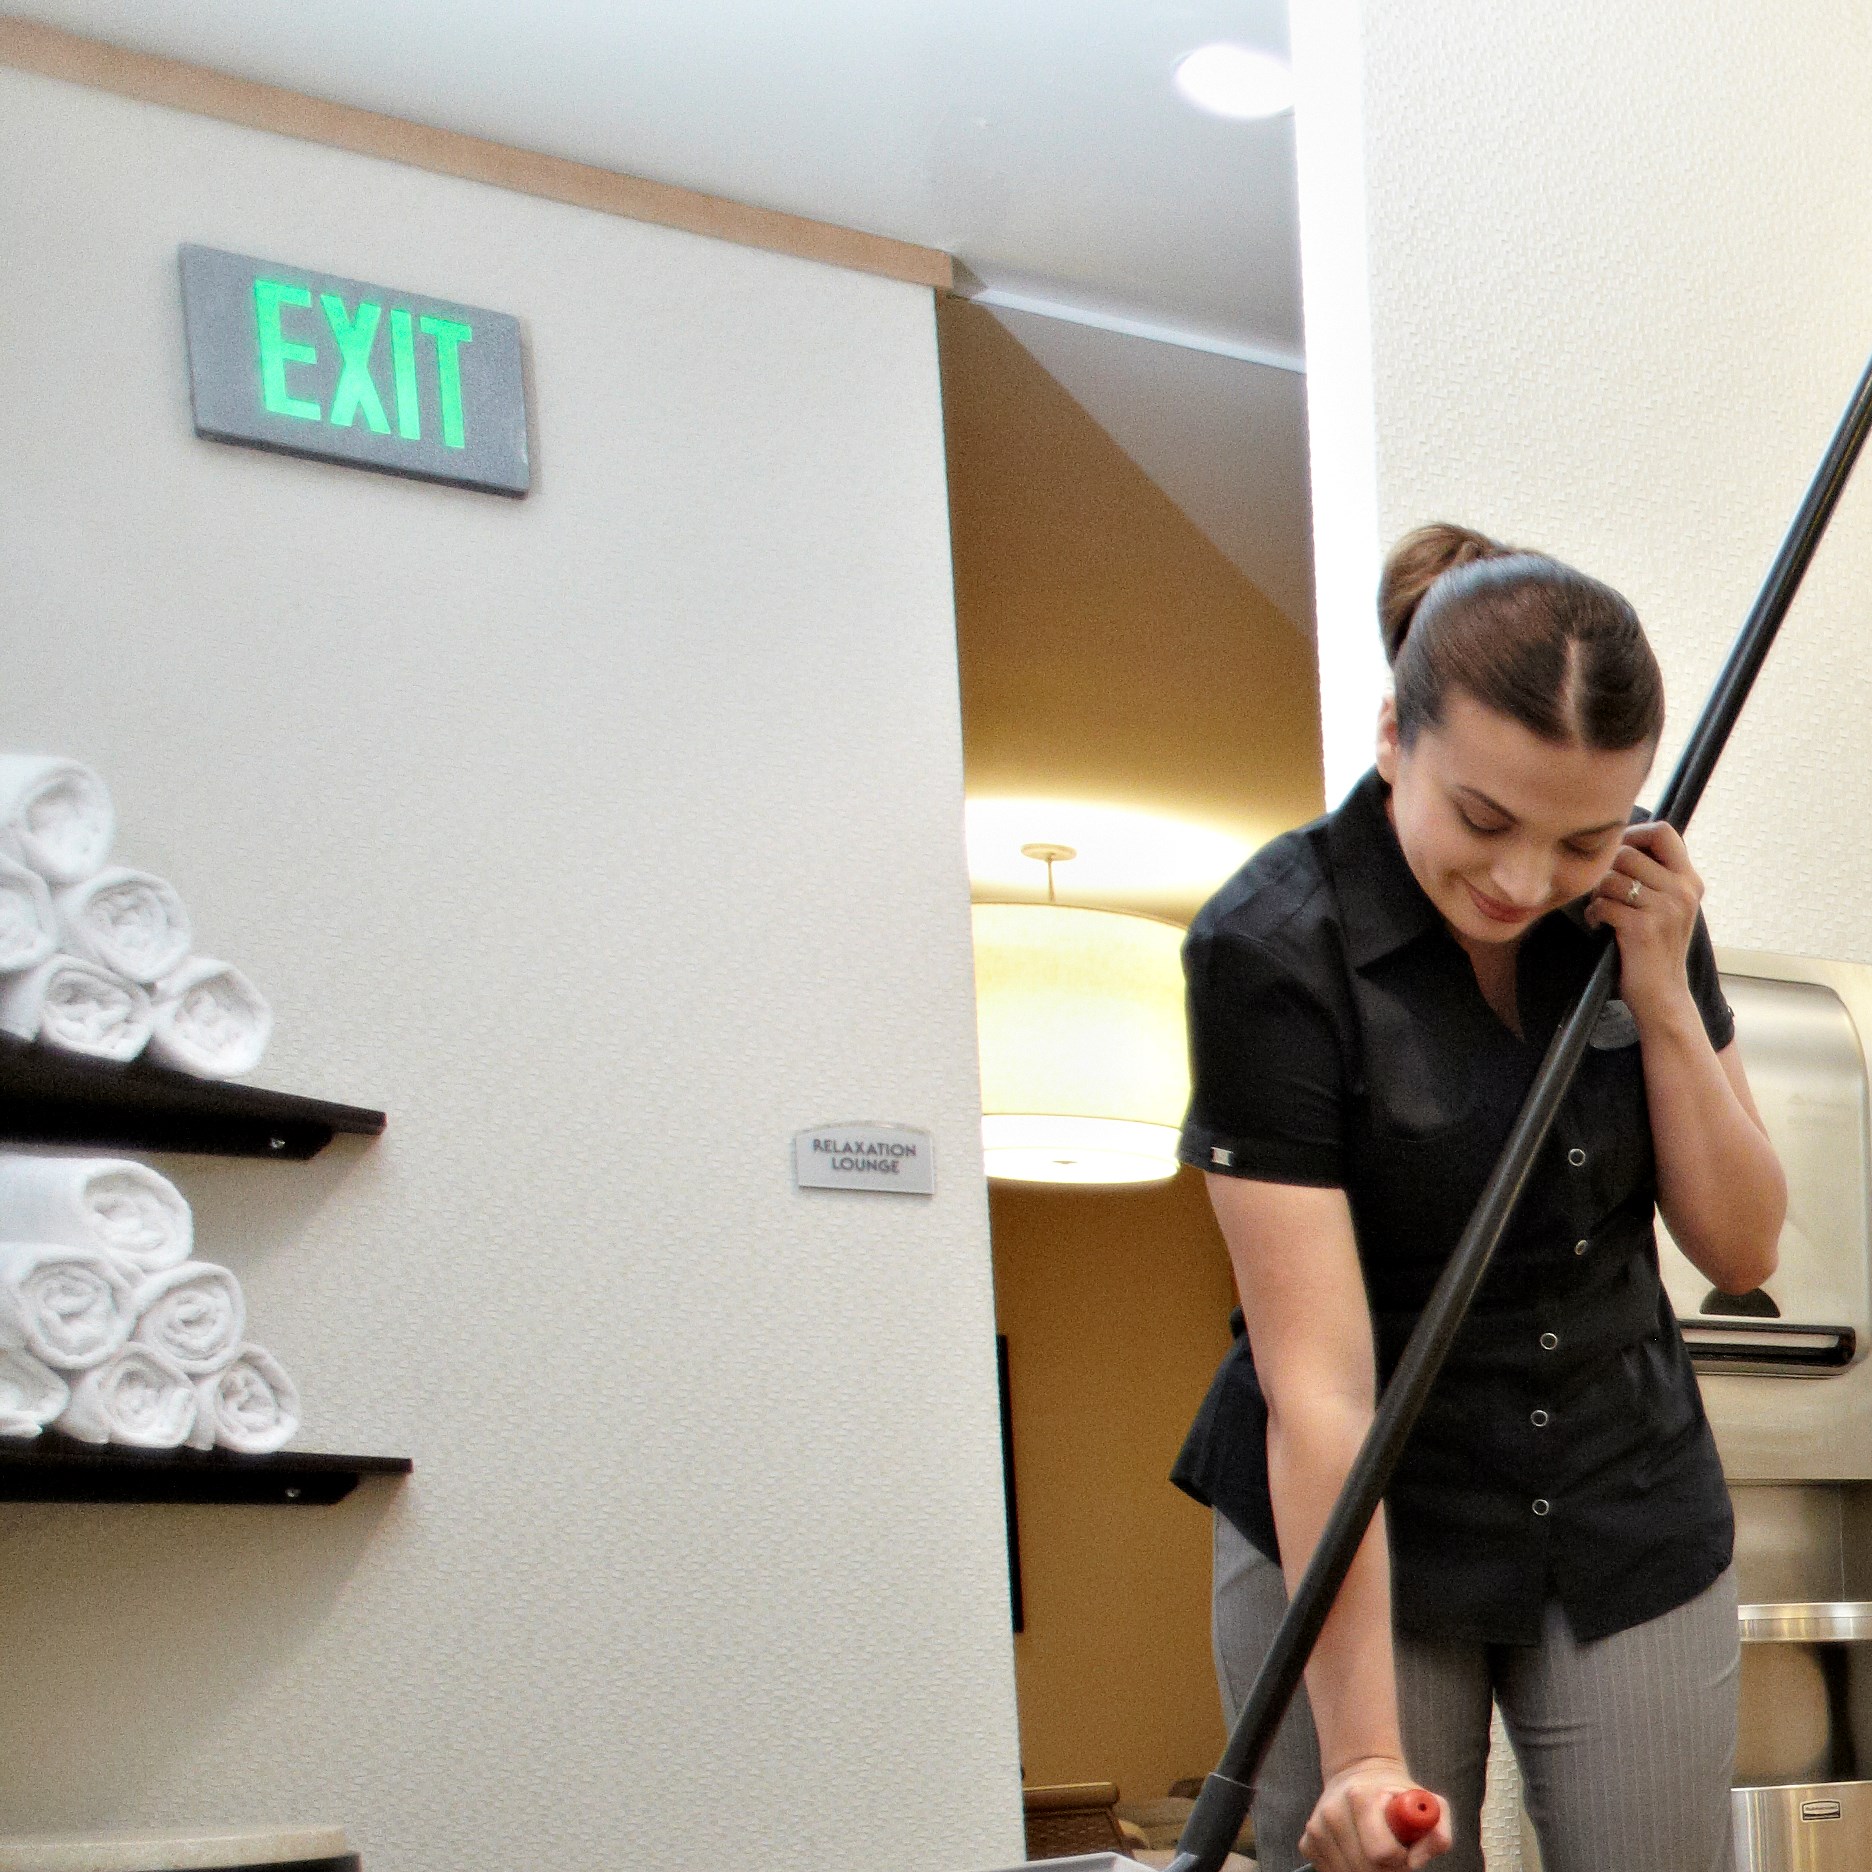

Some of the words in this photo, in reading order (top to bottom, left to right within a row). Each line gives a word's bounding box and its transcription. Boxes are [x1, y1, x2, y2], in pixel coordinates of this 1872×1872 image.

[253, 279, 472, 449] EXIT
[812, 1138, 917, 1157] RELAXATION
[831, 1156, 901, 1174] LOUNGE
